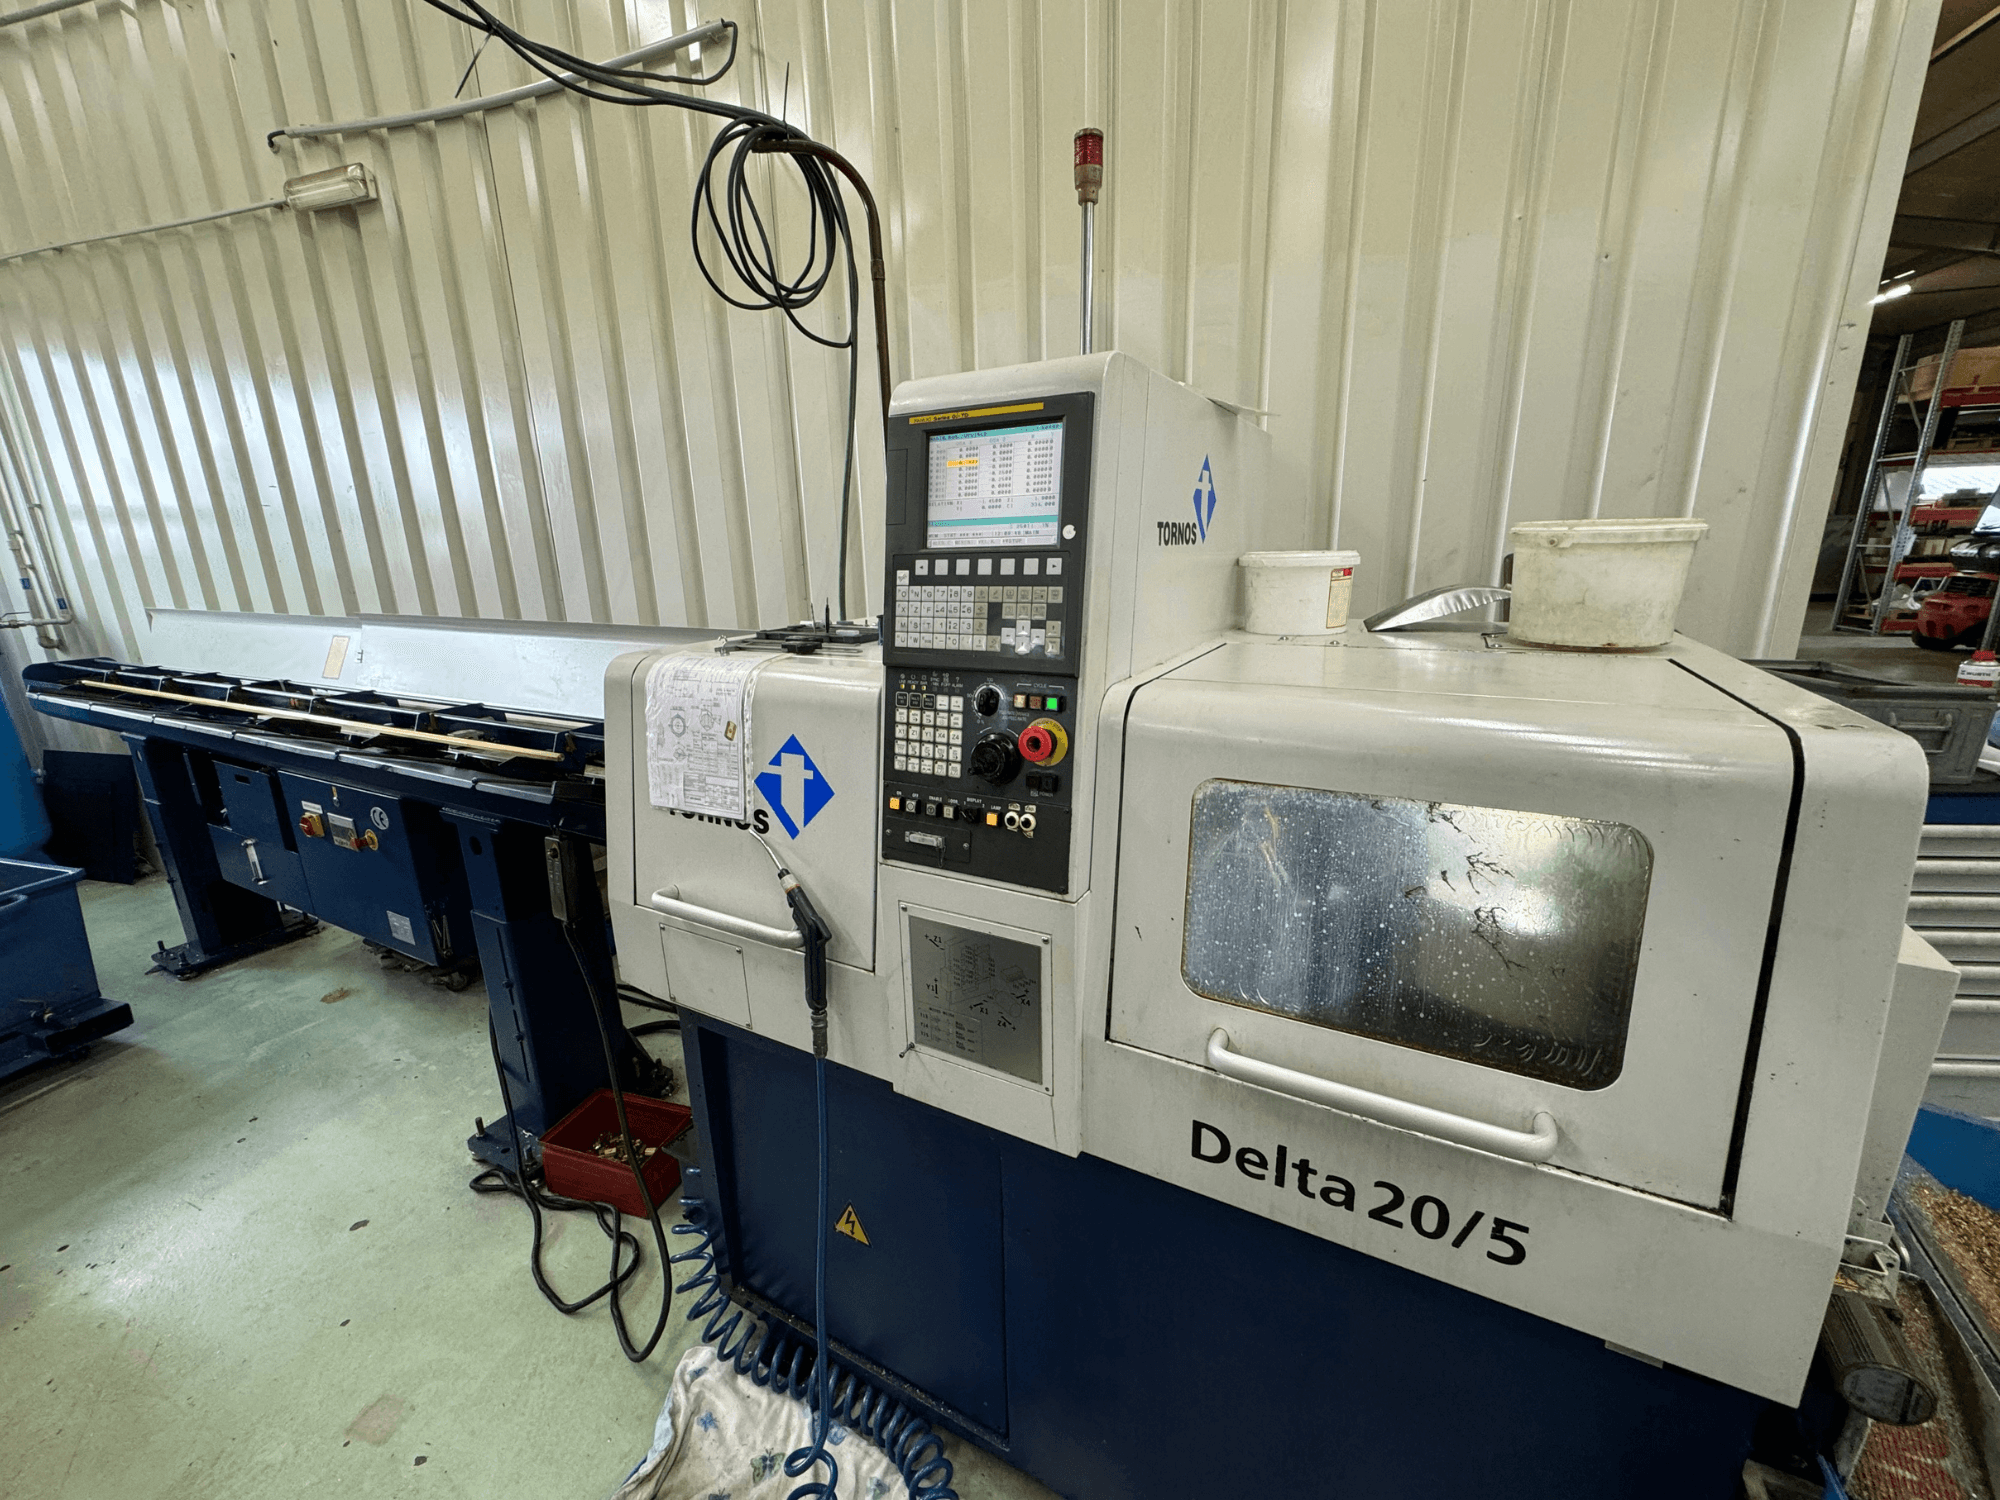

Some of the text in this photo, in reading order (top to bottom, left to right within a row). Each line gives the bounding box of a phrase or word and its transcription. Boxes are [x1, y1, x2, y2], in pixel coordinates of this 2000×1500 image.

[1157, 521, 1197, 546] TORNOS
[934, 935, 942, 944] Z1
[926, 983, 934, 992] Y1
[1020, 998, 1031, 1006] X4
[980, 1006, 989, 1015] X1
[997, 1019, 1007, 1028] Z4
[1190, 1119, 1530, 1266] Delta 20/5
